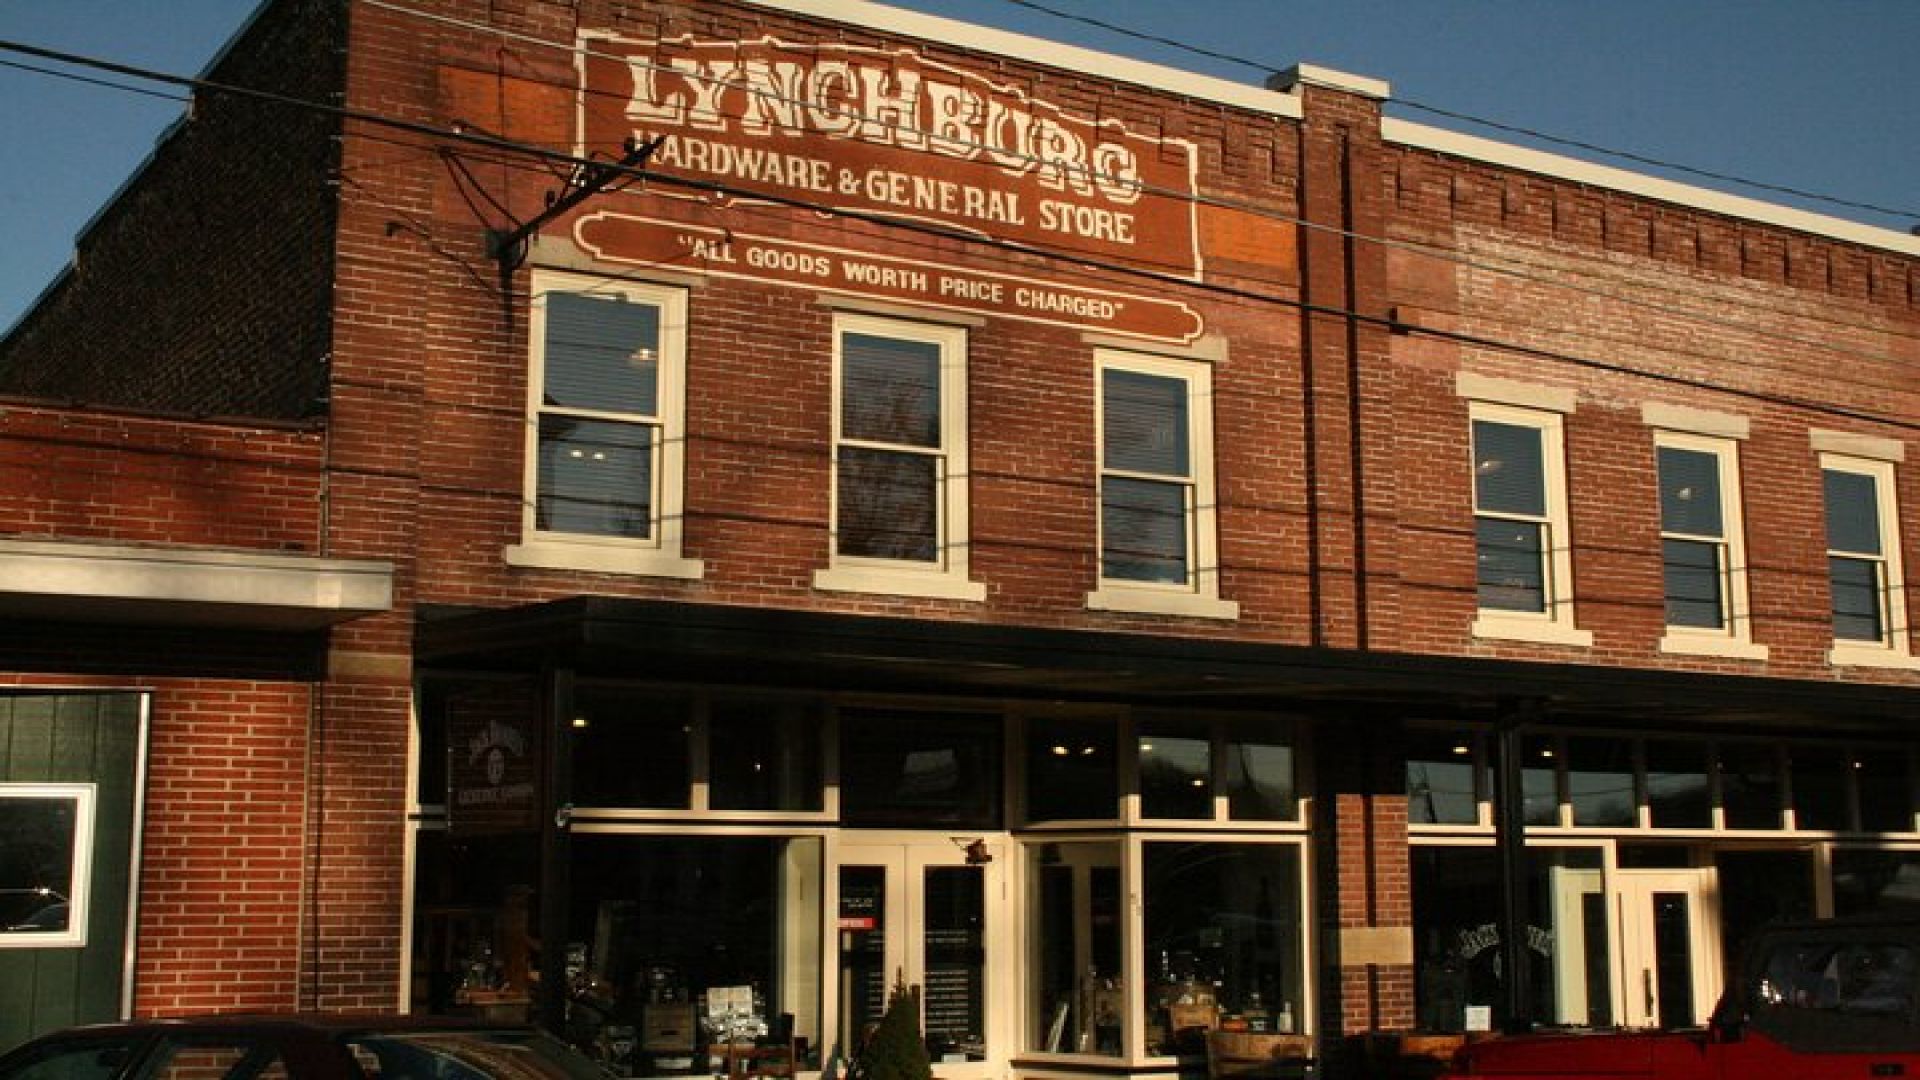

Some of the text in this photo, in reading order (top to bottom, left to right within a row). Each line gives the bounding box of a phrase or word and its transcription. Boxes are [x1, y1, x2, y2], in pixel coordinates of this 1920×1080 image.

[624, 56, 1143, 203] LYNCHBURG
[632, 129, 1135, 244] HARDWARE & GENERAL STORE
[746, 247, 830, 277] GOODS
[842, 261, 928, 291] WORTH
[940, 276, 1003, 303] PRICE
